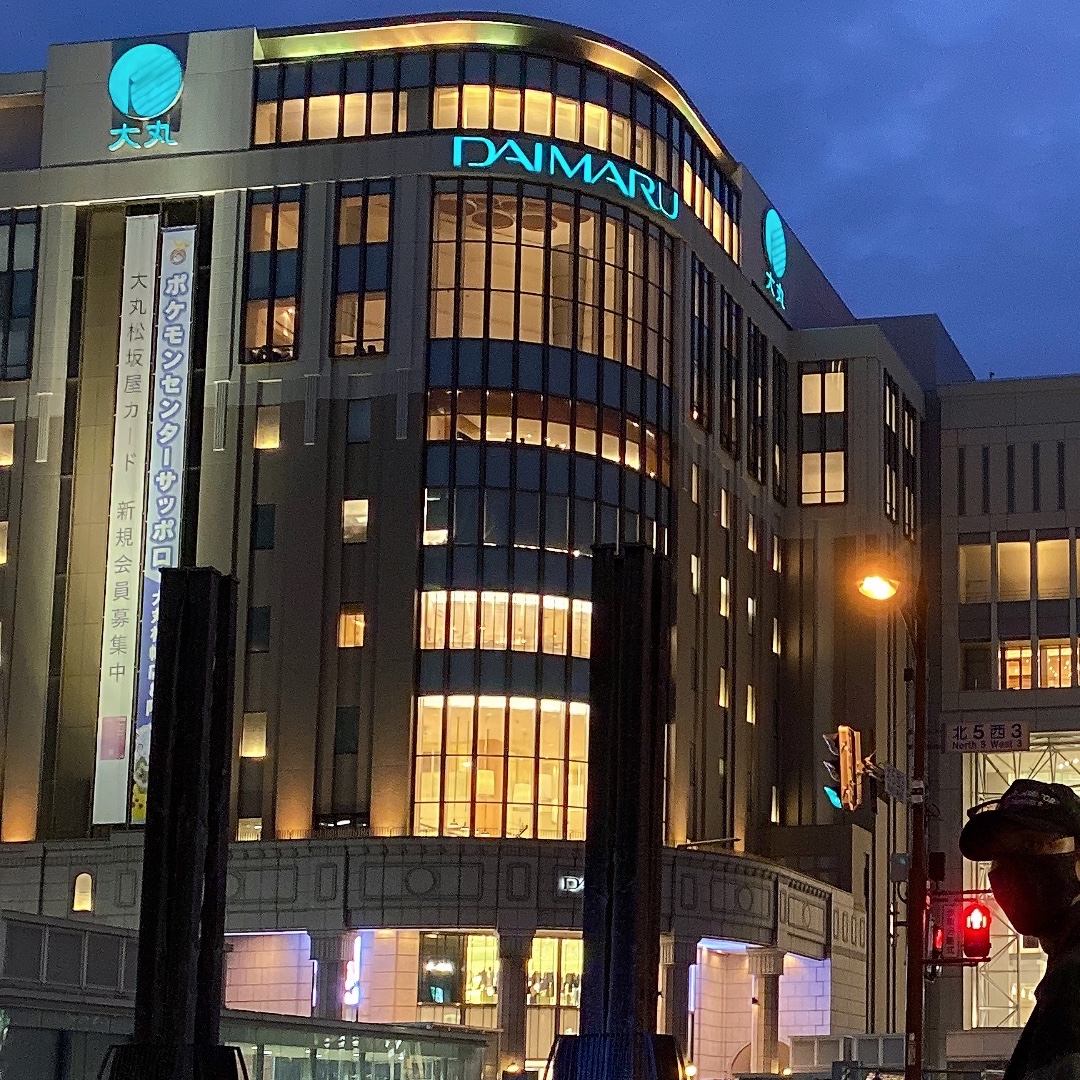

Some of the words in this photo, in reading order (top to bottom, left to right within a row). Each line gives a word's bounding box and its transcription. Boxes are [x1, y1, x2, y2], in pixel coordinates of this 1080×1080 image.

[108, 119, 178, 152] 大丸
[452, 136, 679, 220] DAIMARU
[123, 272, 148, 472] 大丸松坂屋カード
[150, 272, 189, 570] ポケモンセンターサッポロ
[109, 500, 136, 683] 新規会員募集中
[952, 741, 977, 750] North
[990, 740, 1013, 749] West
[1016, 740, 1022, 748] 3
[559, 876, 584, 892] D
